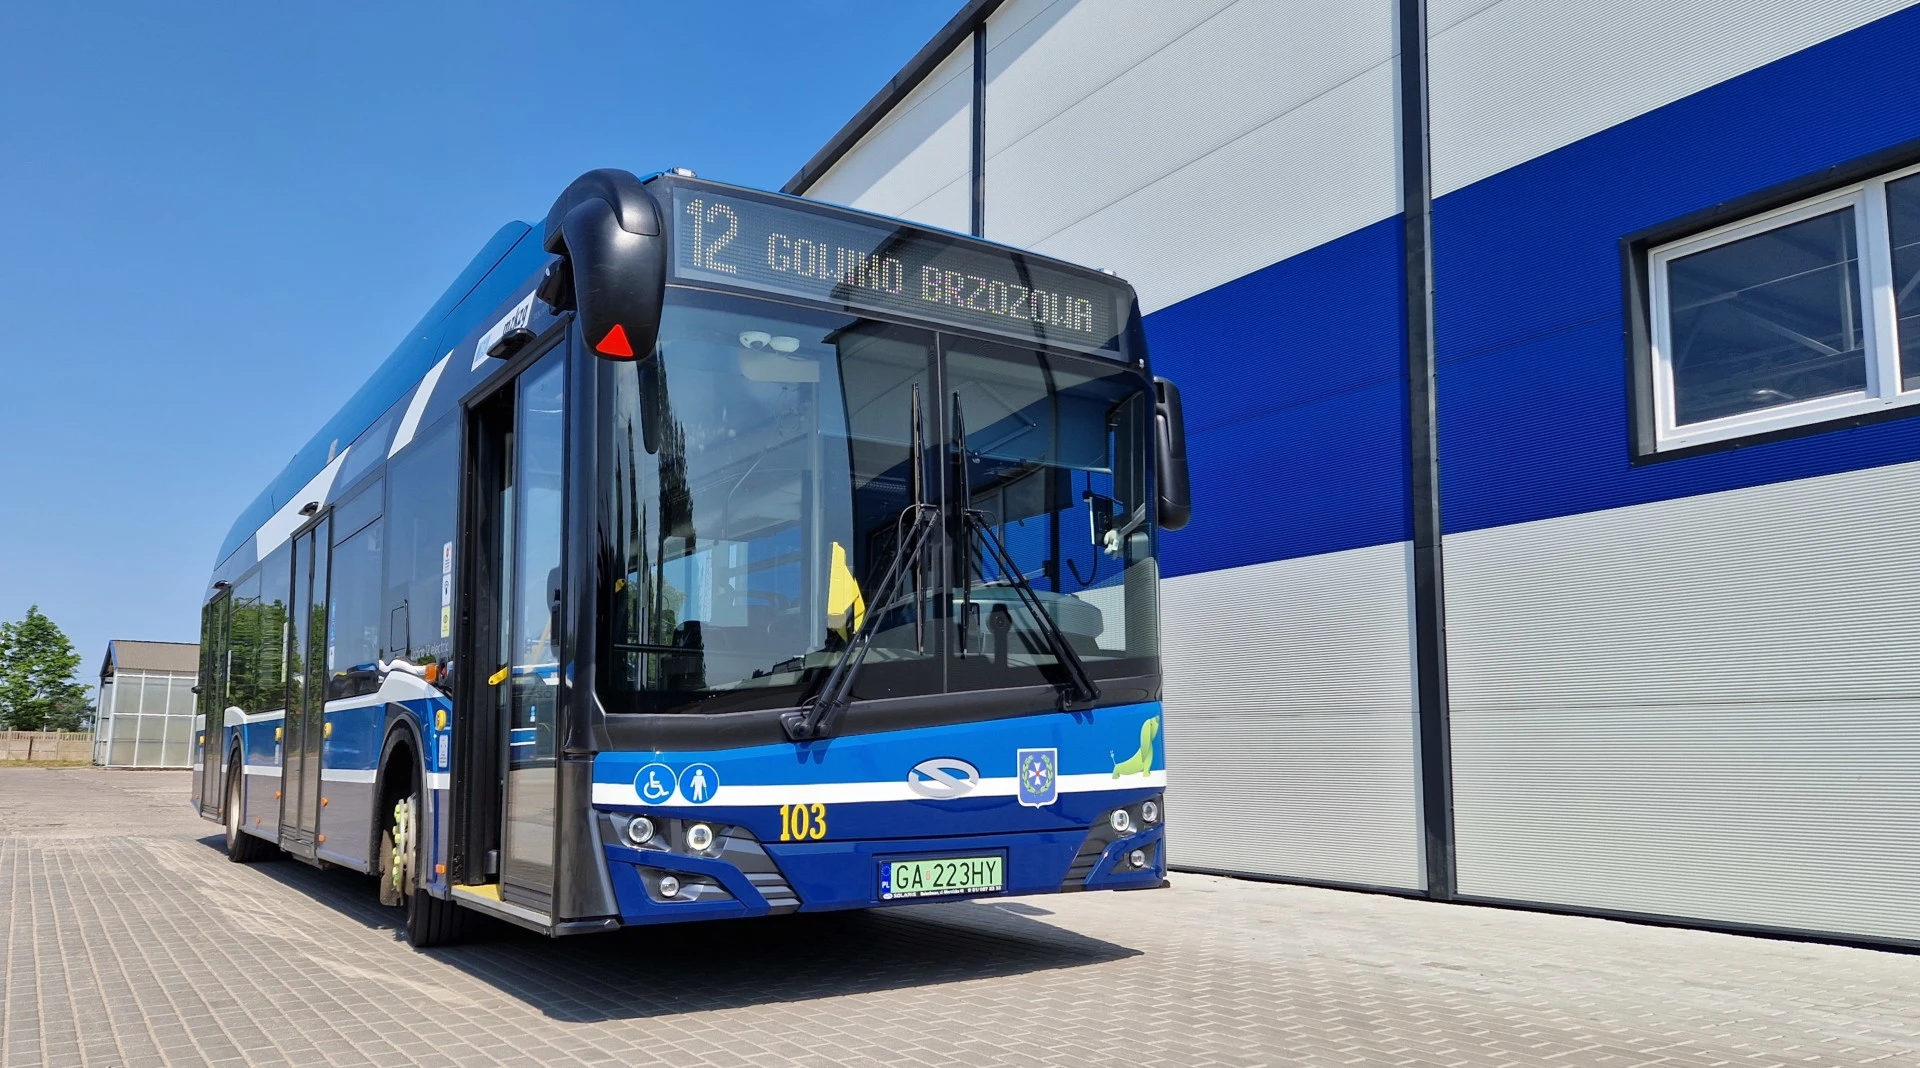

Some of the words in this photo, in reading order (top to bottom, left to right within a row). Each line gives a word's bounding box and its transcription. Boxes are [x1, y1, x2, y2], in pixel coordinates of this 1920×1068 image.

[686, 198, 738, 274] 12
[767, 232, 903, 295] GOWINO
[922, 265, 1092, 332] BRZOZOWA
[430, 639, 449, 656] electric
[780, 803, 826, 842] 103
[882, 881, 890, 889] PL
[896, 864, 923, 889] GA
[933, 861, 997, 889] 223HY
[893, 891, 917, 899] SOLARIS
